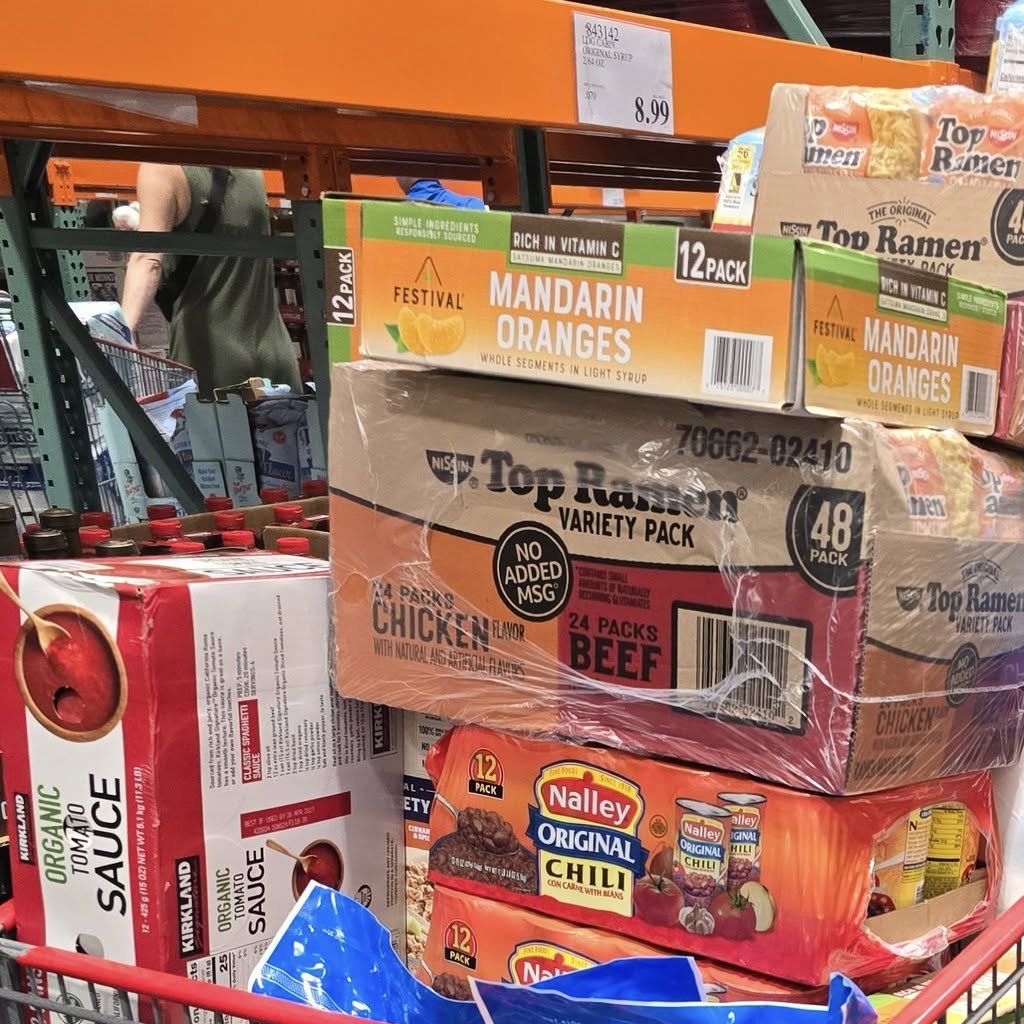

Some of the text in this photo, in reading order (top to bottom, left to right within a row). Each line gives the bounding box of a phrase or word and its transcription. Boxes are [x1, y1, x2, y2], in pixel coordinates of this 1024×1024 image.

[585, 22, 620, 42] 843142
[582, 47, 633, 62] ORIGINAL SYRUP
[635, 96, 670, 125] 8.99
[937, 117, 986, 151] Top
[930, 146, 1021, 178] Ramen
[393, 216, 479, 234] SIMPLE INGREDIENTS
[868, 204, 932, 226] THE ORIGINAL
[396, 227, 477, 244] RESPONSIBLY SOURCED
[513, 232, 620, 257] RICH IN VITAMIN C
[782, 220, 981, 262] NISSIN Top Ramen
[512, 252, 545, 264] SATSUMA
[548, 256, 585, 268] MANDARIN
[394, 286, 463, 310] FESTIVAL
[489, 270, 644, 324] MANDARIN
[881, 276, 946, 306] RICH VITAMIN C
[497, 313, 632, 364] ORANGES
[813, 320, 856, 342] FESTIVAL
[864, 316, 959, 368] MANDARIN
[480, 351, 648, 385] WHOLE SEGMENTS IN LIGHT SYRUP
[868, 358, 951, 405] ORANGES
[675, 423, 852, 475] 70662-02410
[432, 454, 469, 473] NISSIN
[480, 448, 565, 512] Top
[558, 506, 695, 548] VARIETY PACK
[810, 500, 853, 551] 48
[515, 541, 542, 562] NO
[809, 548, 848, 567] PACK
[504, 561, 562, 585] ADDED
[399, 585, 454, 609] PACKS
[517, 583, 556, 605] MSG
[926, 581, 962, 622] Top
[372, 603, 526, 652] CHICKEN FLAVOR
[569, 612, 658, 642] 24 PACKS
[954, 615, 1013, 634] VARIETY PACK
[373, 637, 393, 658] WITH
[394, 642, 427, 664] NATURAL
[568, 631, 662, 683] BEEF
[418, 725, 434, 736] 100%
[875, 706, 937, 736] CHICKEN
[241, 704, 252, 780] CLASSIC SPAGHETTI
[252, 753, 261, 779] SAUCE
[475, 751, 497, 781] 12
[475, 781, 498, 796] PACK
[549, 784, 631, 826] Nalley
[15, 794, 31, 862] KIRKLAND
[37, 784, 68, 885] ORGANIC
[67, 803, 89, 876] TOMATO
[537, 822, 636, 864] ORIGINAL
[684, 823, 721, 843] Nalley
[89, 773, 128, 916] SAUCE
[680, 839, 722, 859] ORIGINAL
[136, 805, 150, 933] 12 425 (15 OZ) NET WT kg
[545, 859, 626, 891] CHILI
[684, 855, 716, 870] CHILI
[217, 867, 232, 933] ORGANIC
[233, 872, 244, 918] TOMATO
[247, 846, 266, 935] SAUCE
[547, 879, 624, 901] CON CARNE WITH BEANS
[177, 860, 196, 955] KIRKLAND
[451, 924, 471, 953] 12
[219, 954, 228, 973] 25
[449, 951, 471, 967] PACK
